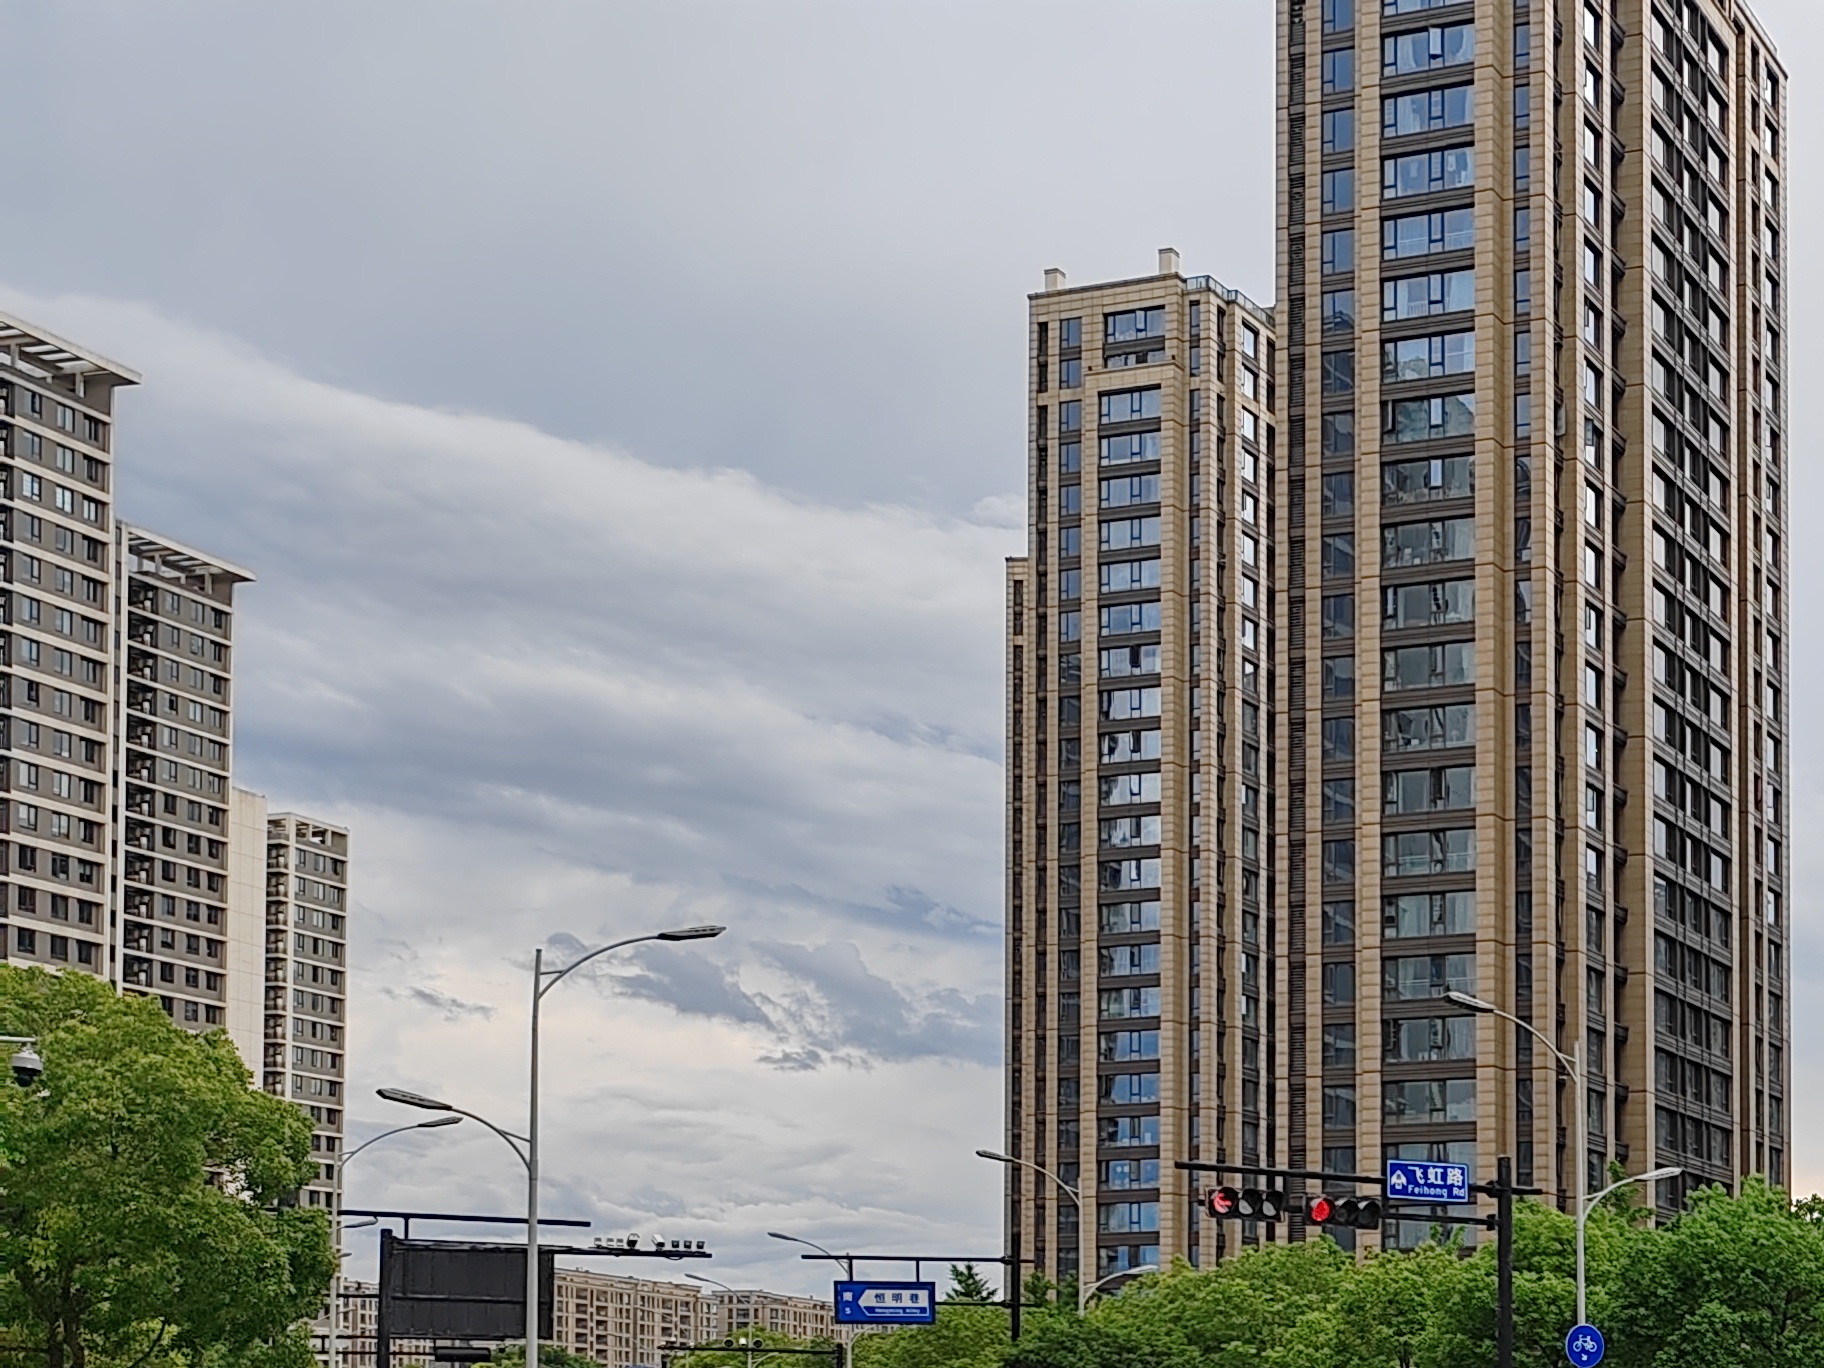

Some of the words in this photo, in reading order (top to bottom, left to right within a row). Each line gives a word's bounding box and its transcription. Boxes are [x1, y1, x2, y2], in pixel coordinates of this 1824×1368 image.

[1407, 1166, 1464, 1187] 飞虹路
[1407, 1184, 1448, 1198] Feihong
[1452, 1187, 1465, 1197] Rd
